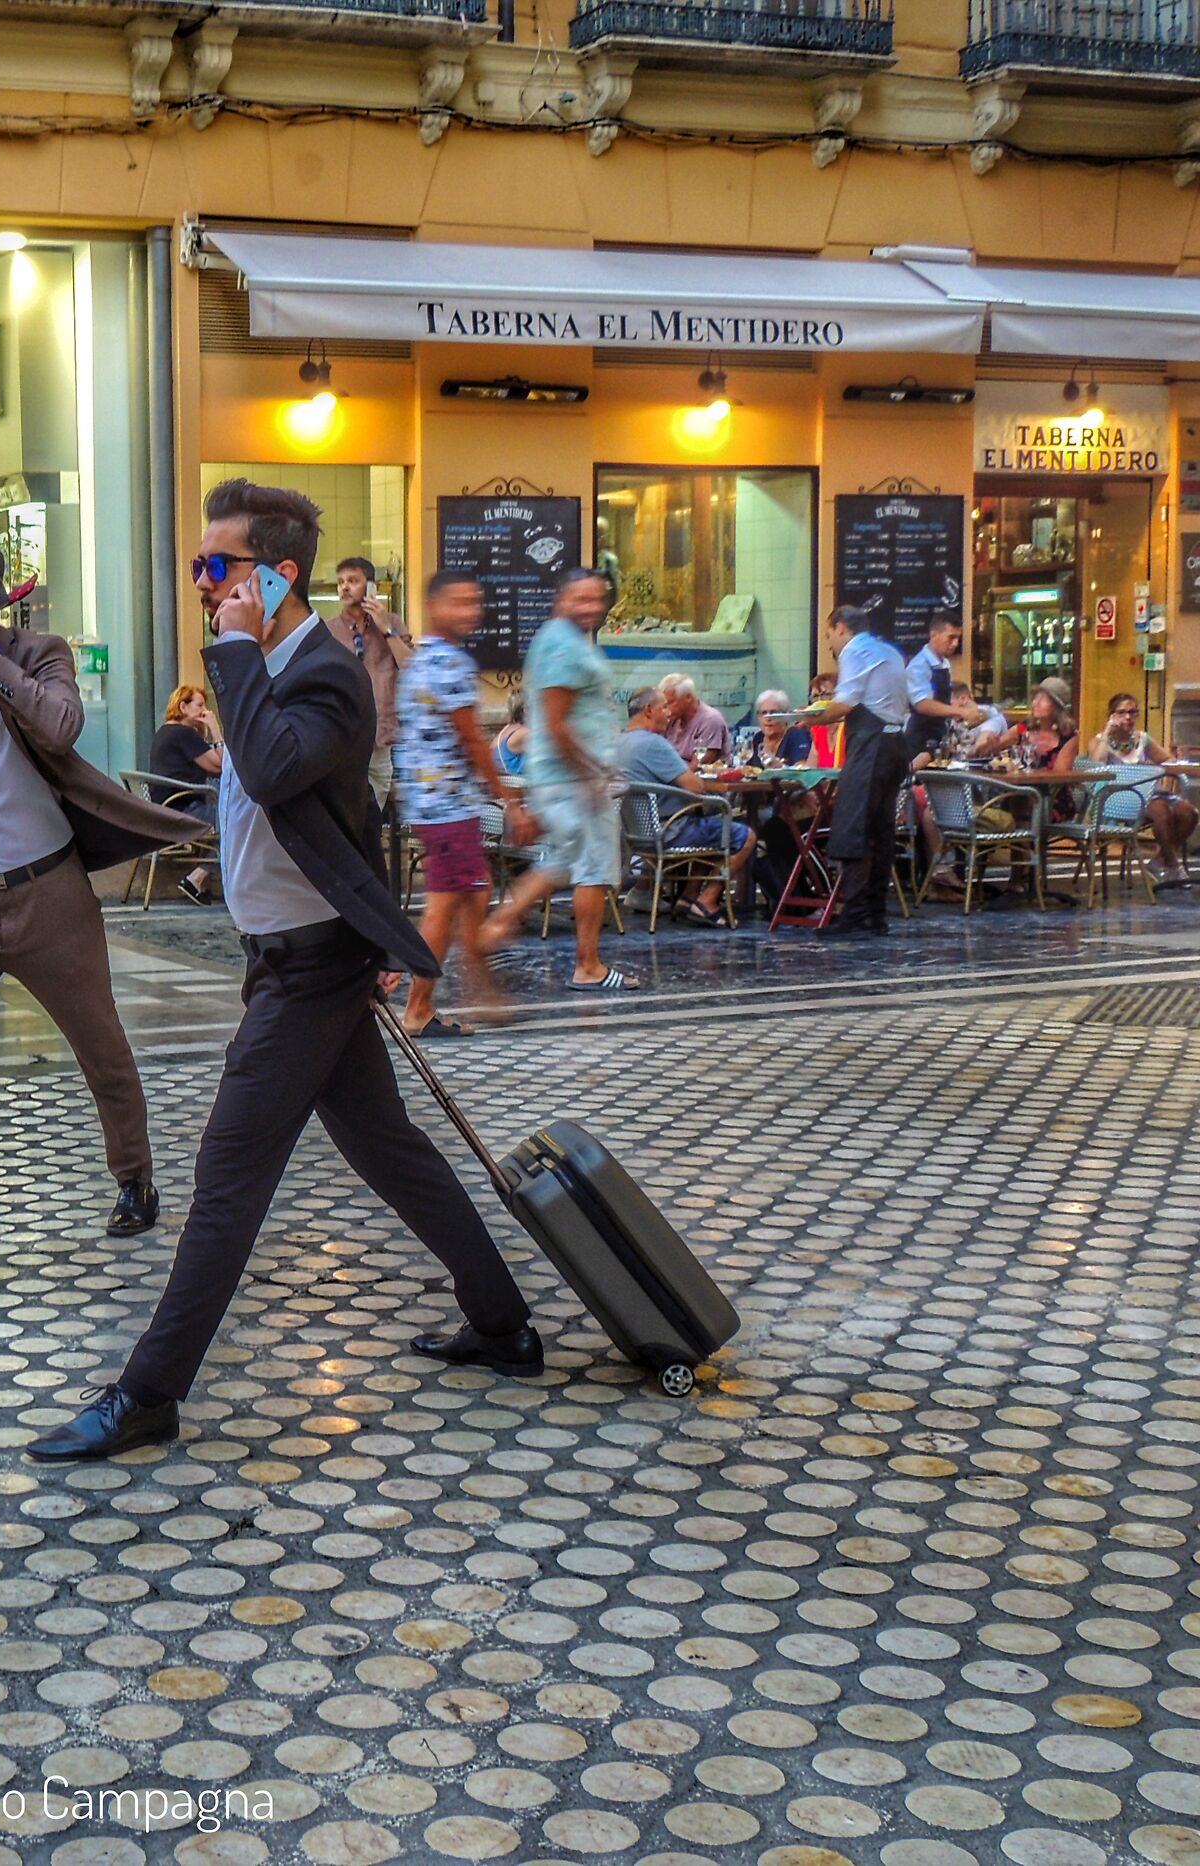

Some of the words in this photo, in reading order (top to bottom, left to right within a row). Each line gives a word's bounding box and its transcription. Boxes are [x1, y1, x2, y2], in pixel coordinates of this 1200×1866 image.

[418, 301, 582, 339] TABERNA
[599, 313, 638, 341] EL
[649, 309, 845, 347] MENTIDERO
[1017, 425, 1126, 447] TABERNA
